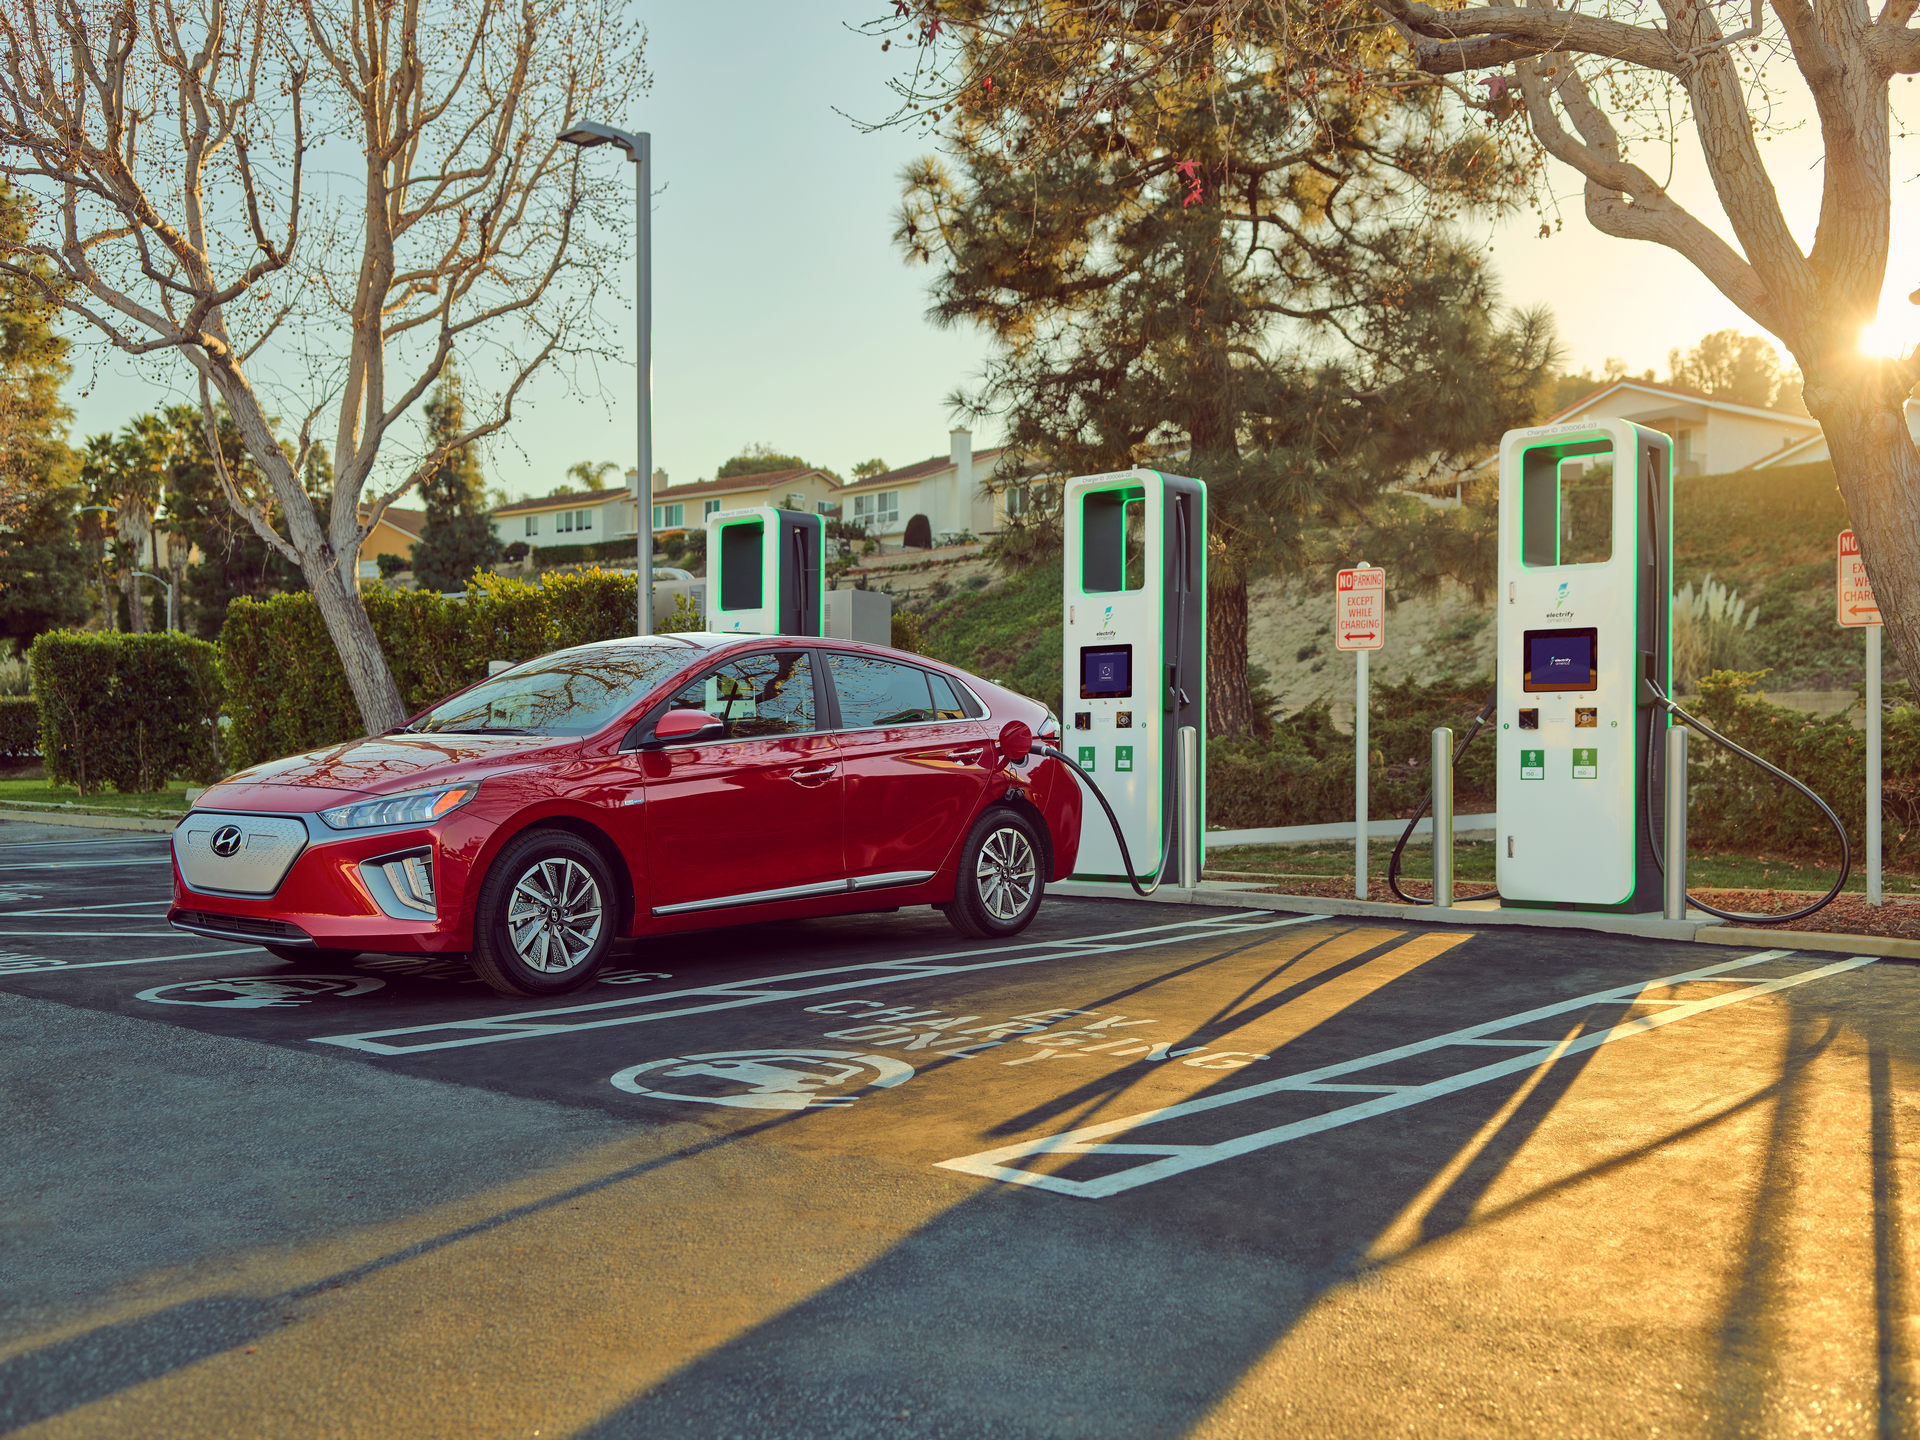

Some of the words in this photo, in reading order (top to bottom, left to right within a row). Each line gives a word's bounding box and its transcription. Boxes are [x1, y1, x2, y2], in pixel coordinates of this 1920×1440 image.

[1526, 428, 1551, 438] Charger
[1339, 574, 1353, 588] NO
[1353, 573, 1382, 587] PARKING
[1347, 596, 1374, 606] EXCEPT
[1348, 608, 1372, 618] WHILE
[1546, 610, 1574, 619] electrify
[1340, 619, 1380, 630] CHARGING
[803, 1000, 1271, 1069] CHARGING
[823, 1024, 1091, 1066] ONLY
